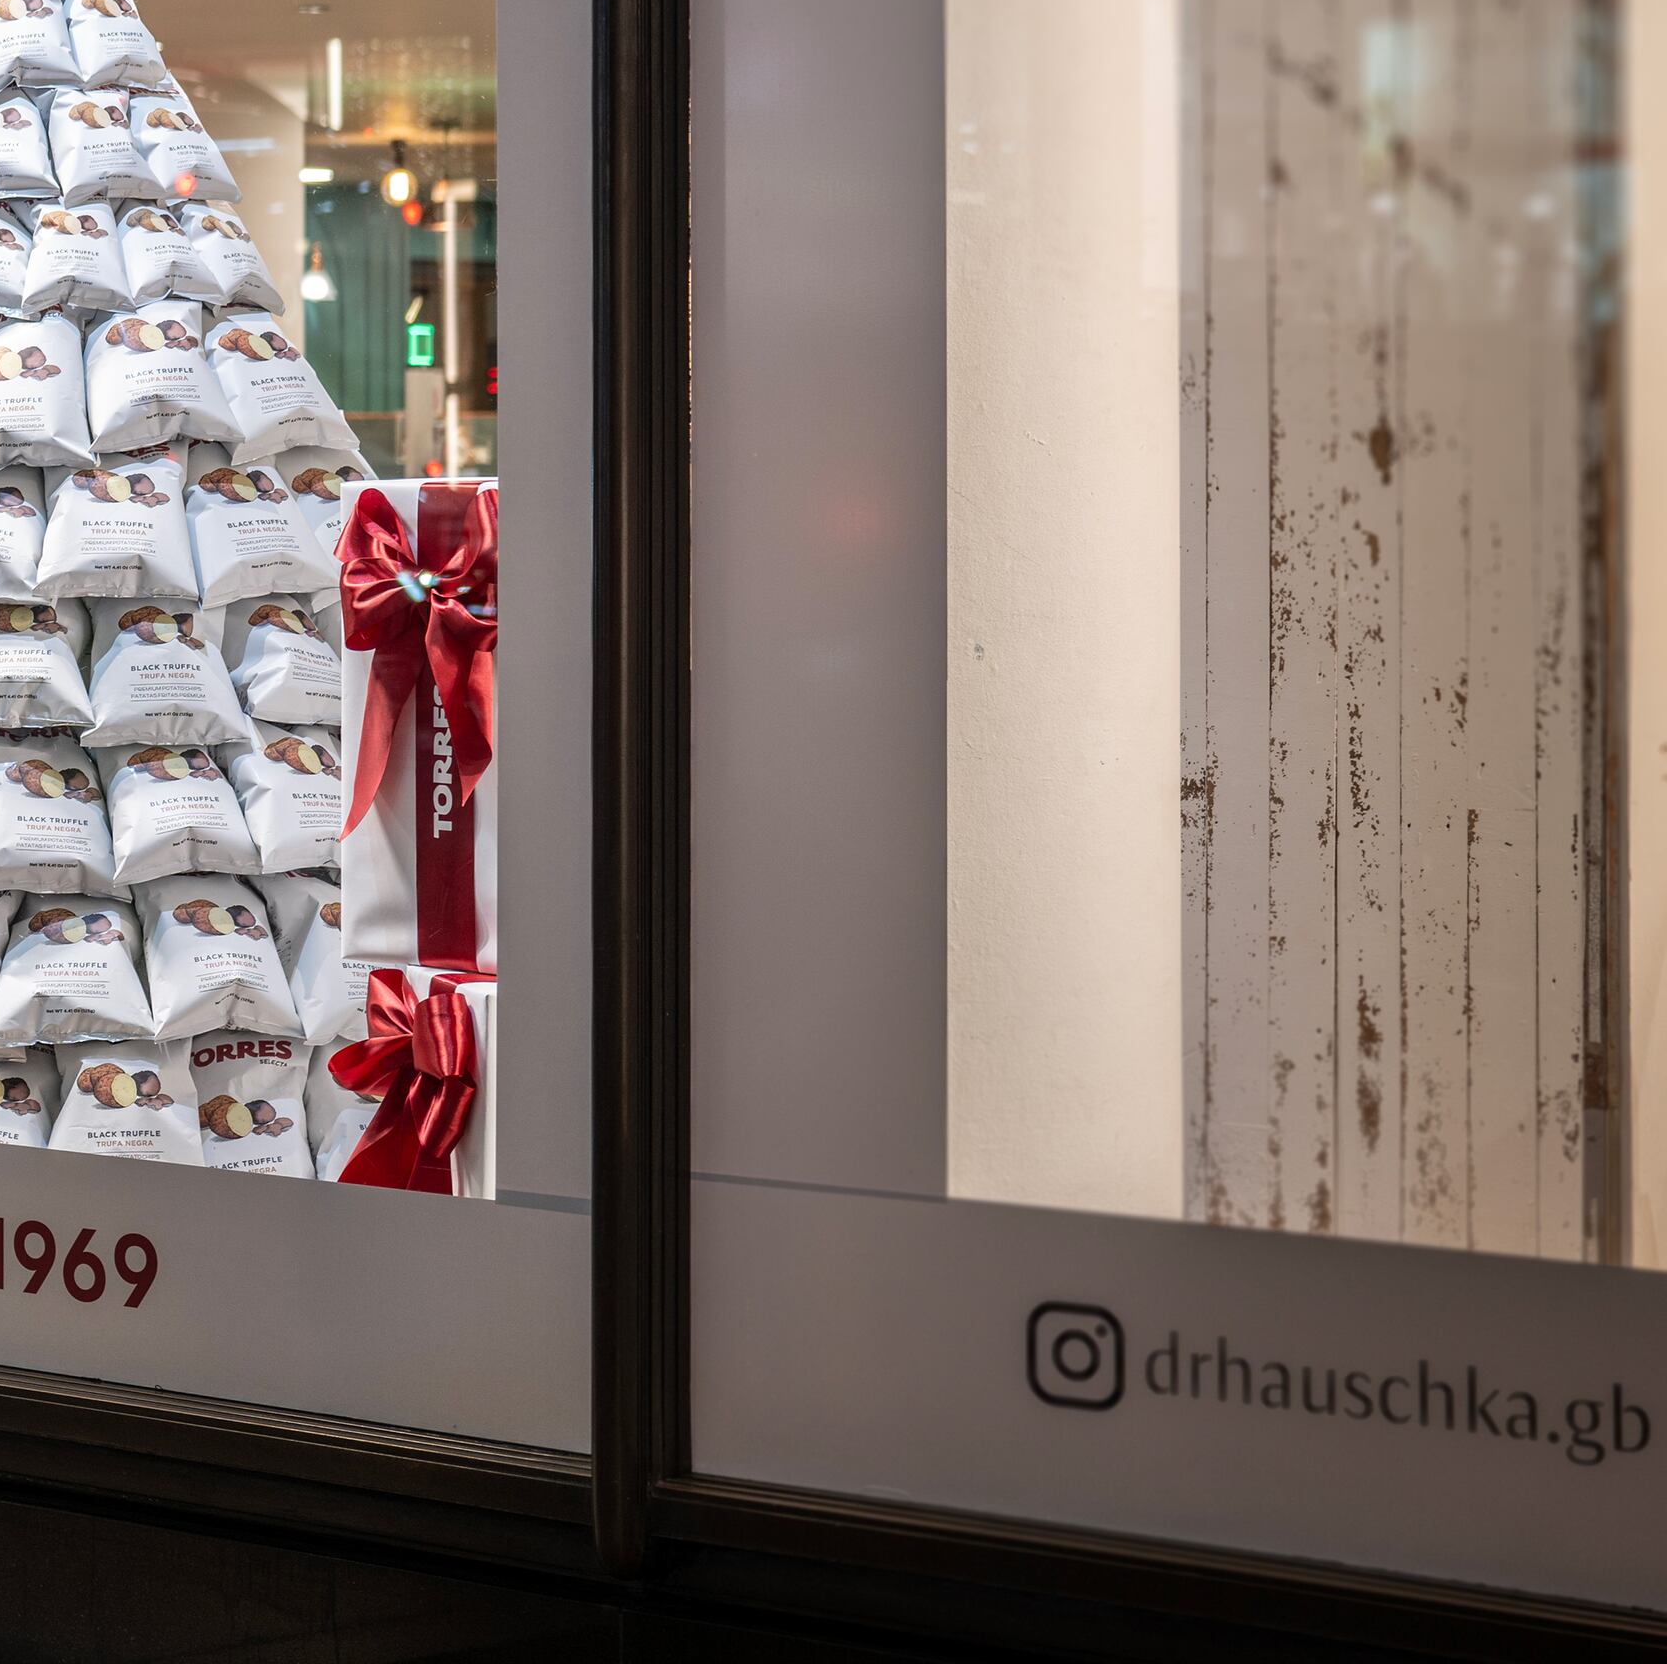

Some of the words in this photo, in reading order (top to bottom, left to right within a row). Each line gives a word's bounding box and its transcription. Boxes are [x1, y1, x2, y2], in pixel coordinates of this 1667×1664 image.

[126, 368, 154, 379] BLACK
[156, 367, 194, 375] TRUFFLE
[135, 377, 160, 385] TRUFA
[163, 375, 188, 383] NEGRA
[251, 378, 274, 386] BLACK
[5, 397, 42, 405] TRUFFLE
[10, 405, 35, 413] NEGRA
[115, 521, 153, 529] TRUFFLE
[227, 520, 253, 529] BLACK
[327, 520, 341, 529] BLA
[120, 528, 146, 536] NEGRA
[131, 663, 160, 672] BLACK
[139, 672, 165, 680] TRUFA
[150, 796, 179, 807] BLACK
[182, 795, 220, 803] TRUFFLE
[161, 804, 186, 812] TRUFA
[49, 816, 89, 826] TRUFFLE
[55, 825, 82, 833] NEGRA
[194, 952, 224, 963] BLACK
[227, 952, 263, 963] TRUFFLE
[204, 961, 233, 969] TRUFA
[236, 960, 258, 969] NEGRA
[342, 962, 365, 970] BLACK
[191, 1040, 292, 1068] ORRES
[259, 1059, 288, 1067] SELECTA
[87, 1130, 116, 1139] BLACK
[96, 1140, 121, 1148] TRUFA
[125, 1139, 154, 1147] NEGRA
[242, 1156, 283, 1166] TRUFFLE
[1144, 1330, 1653, 1468] drhauschka.gb
